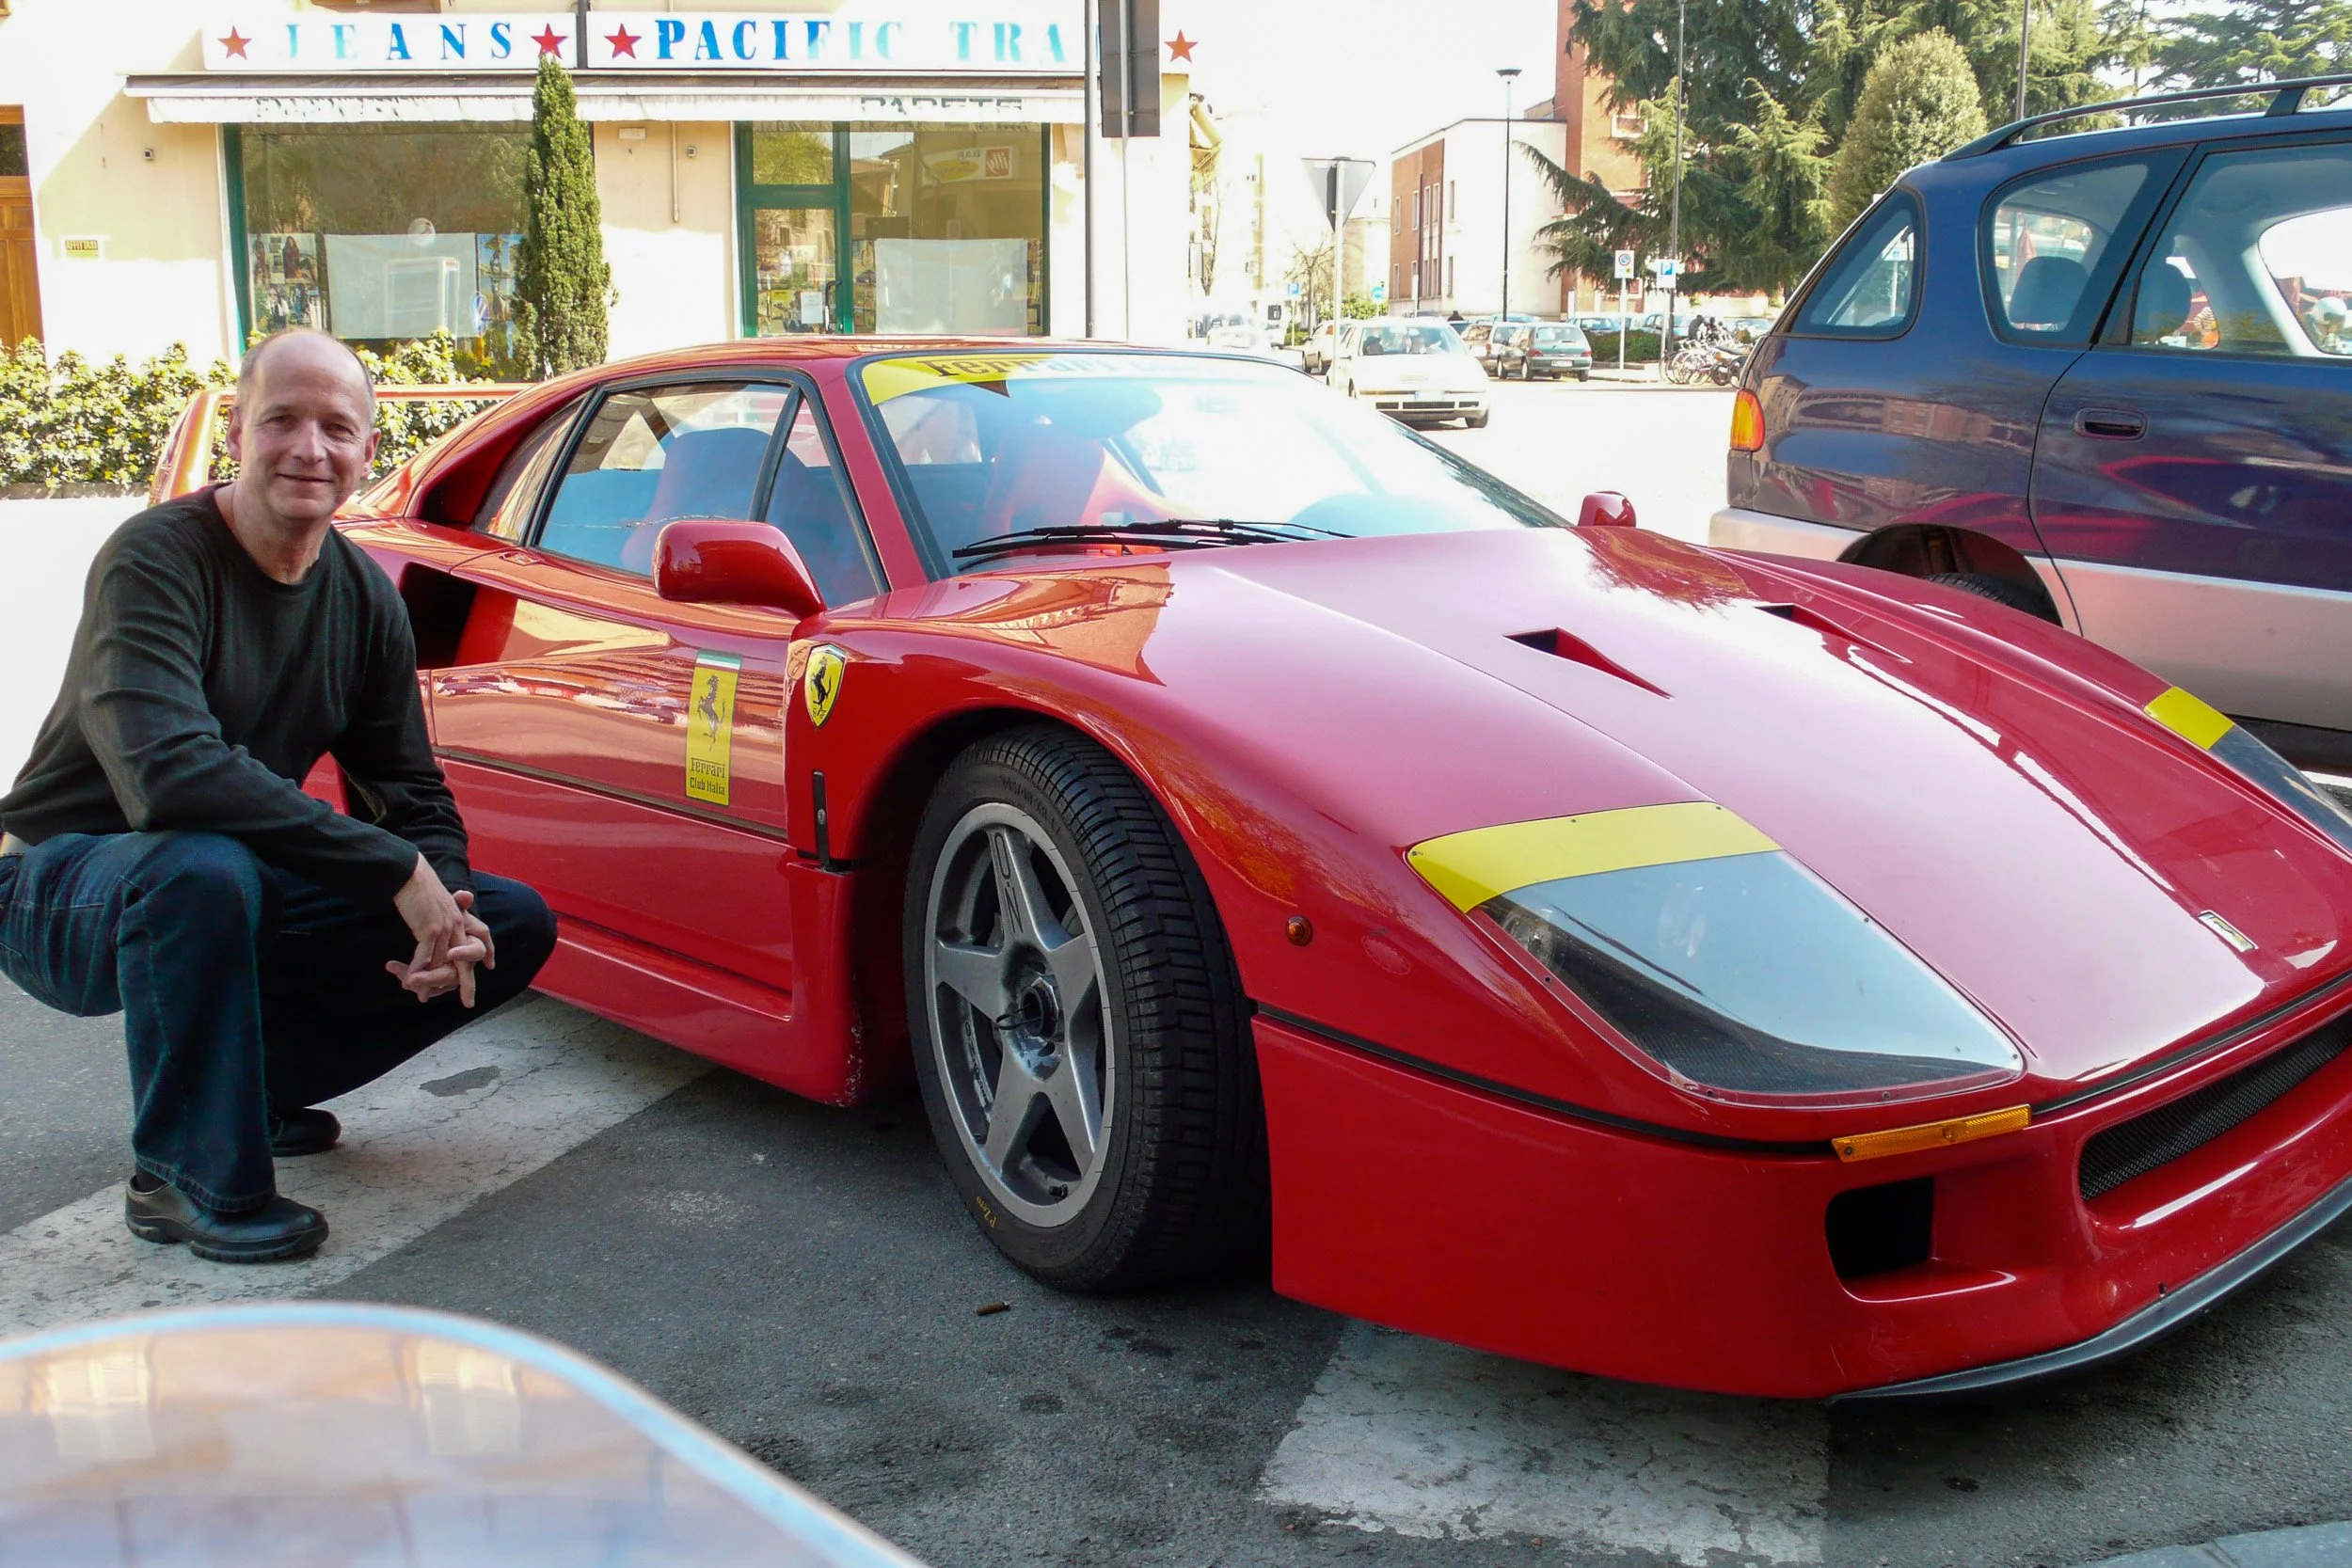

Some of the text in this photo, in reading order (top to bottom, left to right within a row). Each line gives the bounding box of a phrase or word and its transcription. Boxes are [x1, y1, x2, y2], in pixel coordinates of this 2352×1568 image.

[285, 23, 513, 60] JEANS
[655, 20, 903, 61] PACIFIC
[918, 356, 1119, 377] Ferrari
[691, 757, 725, 778] Ferrari
[690, 777, 725, 795] Club Italia
